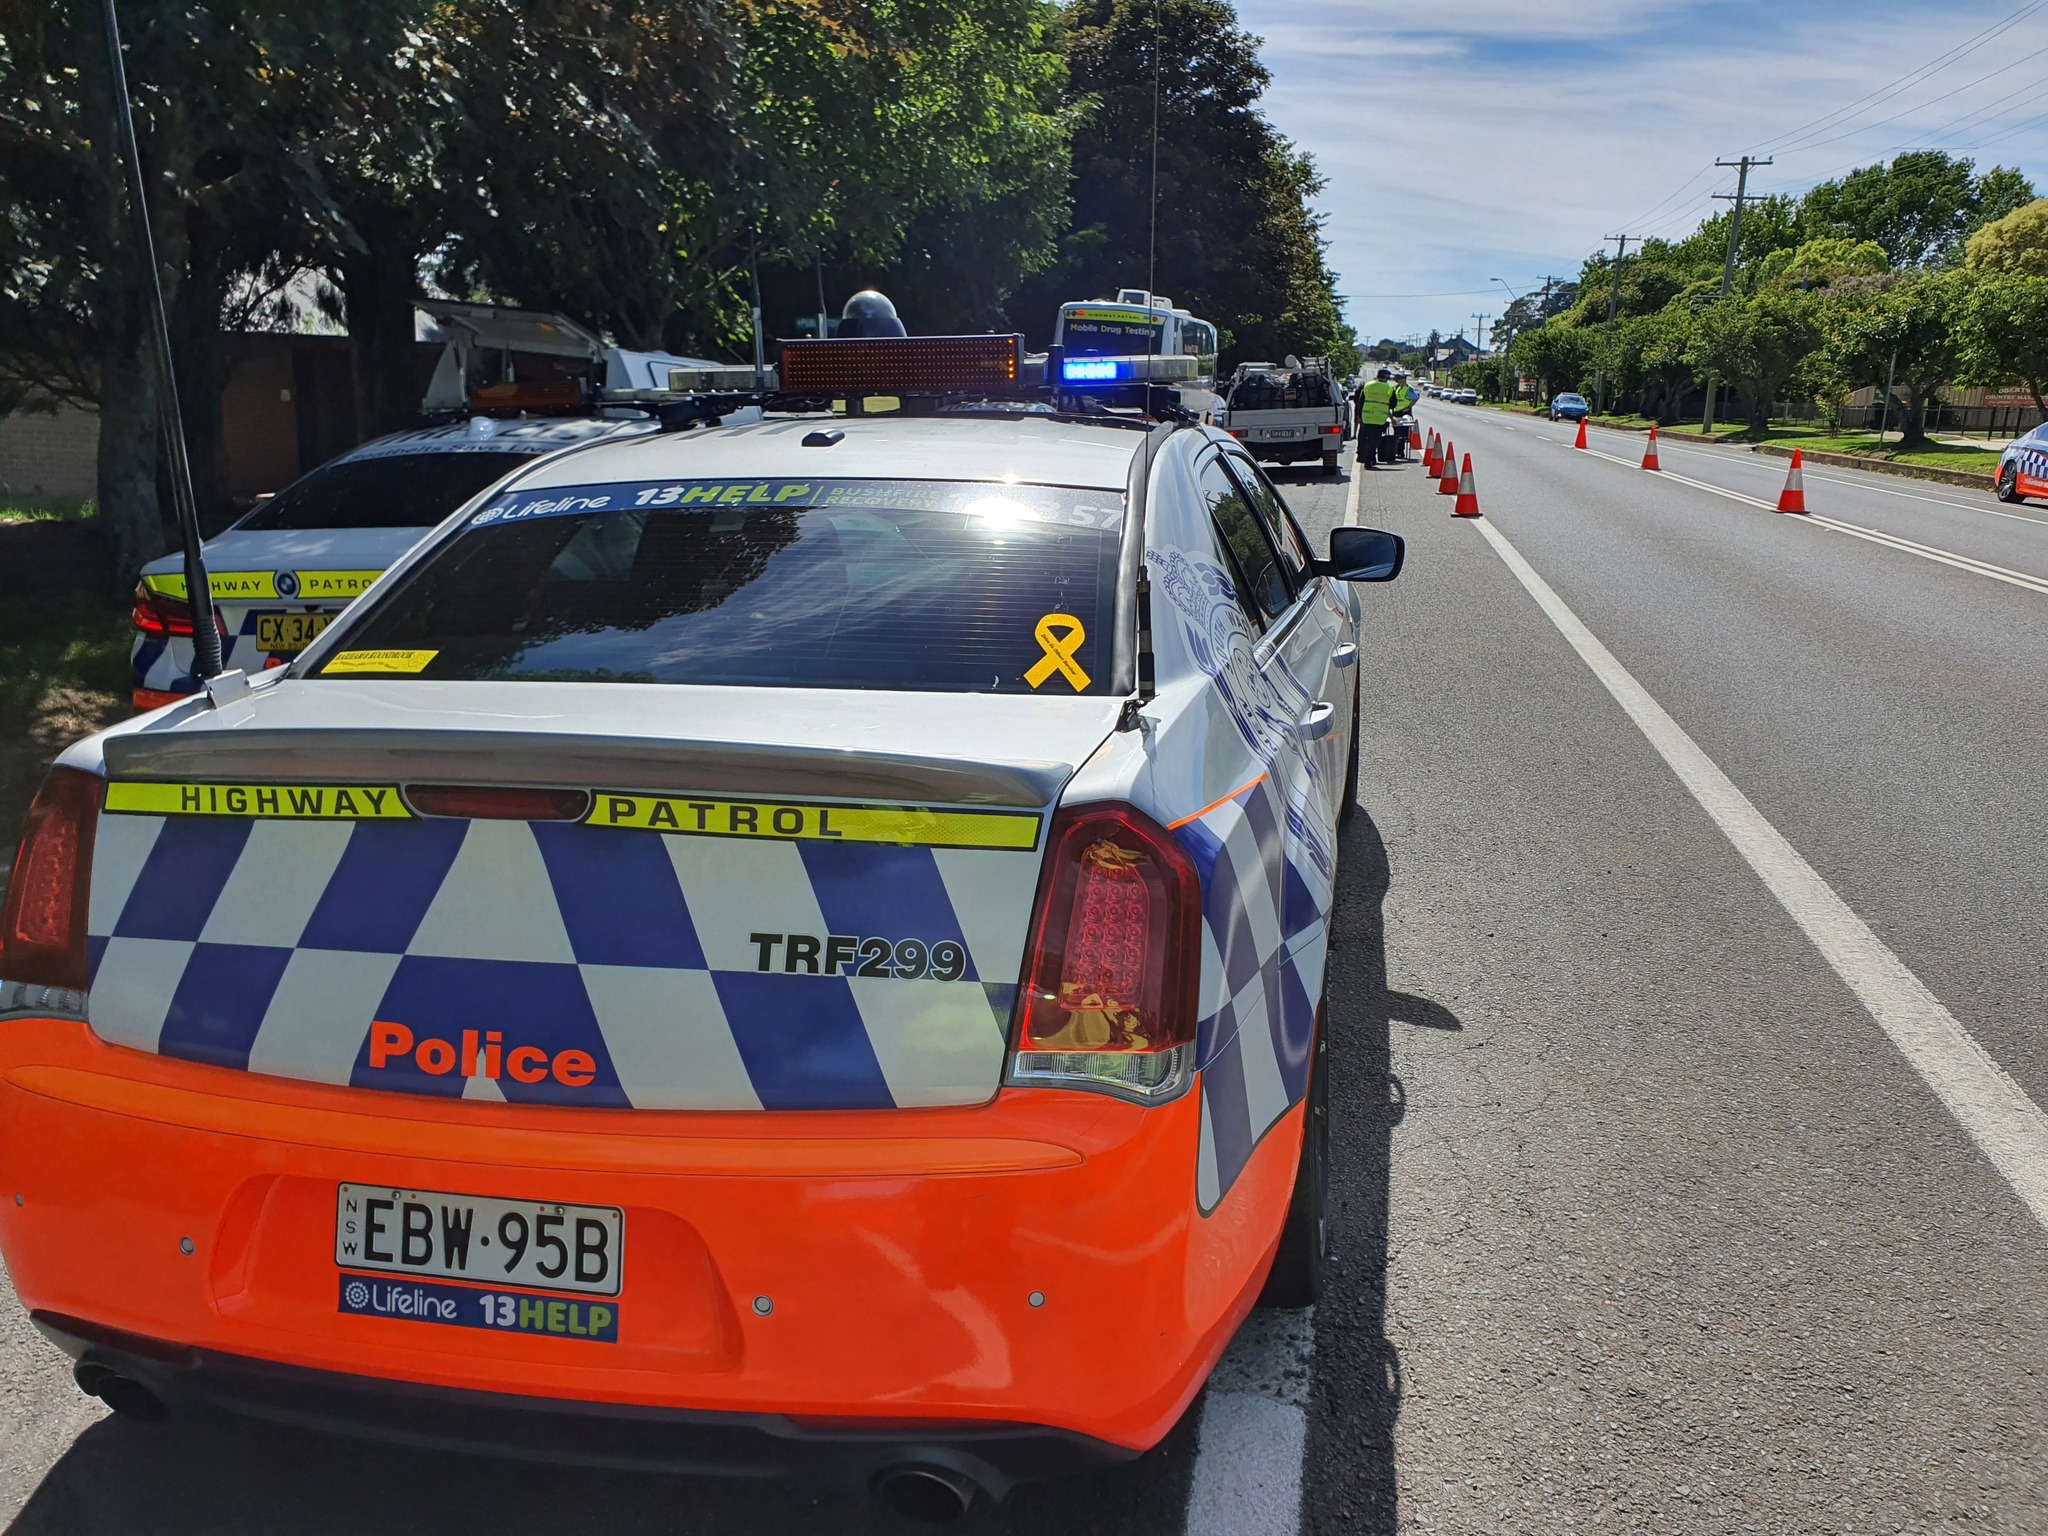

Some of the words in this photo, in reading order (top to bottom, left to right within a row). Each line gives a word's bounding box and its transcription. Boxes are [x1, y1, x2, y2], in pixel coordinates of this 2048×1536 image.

[1070, 323, 1098, 332] Mobile
[1101, 325, 1122, 335] Drug
[1124, 326, 1156, 337] Testing
[508, 444, 553, 453] Live
[502, 495, 611, 520] Lifeline
[635, 485, 811, 505] 13HELP
[825, 495, 938, 508] RECOVERY
[831, 487, 940, 498] BUSHFIRE
[1068, 505, 1123, 528] 57
[181, 580, 262, 591] HHWAY
[309, 578, 374, 590] PATRO
[181, 786, 387, 815] HIGHWAY
[608, 797, 843, 837] PATROL
[749, 932, 967, 982] TRF299
[369, 1020, 597, 1087] Police
[373, 1285, 457, 1319] Lifeline
[479, 1294, 612, 1336] 13HELP
